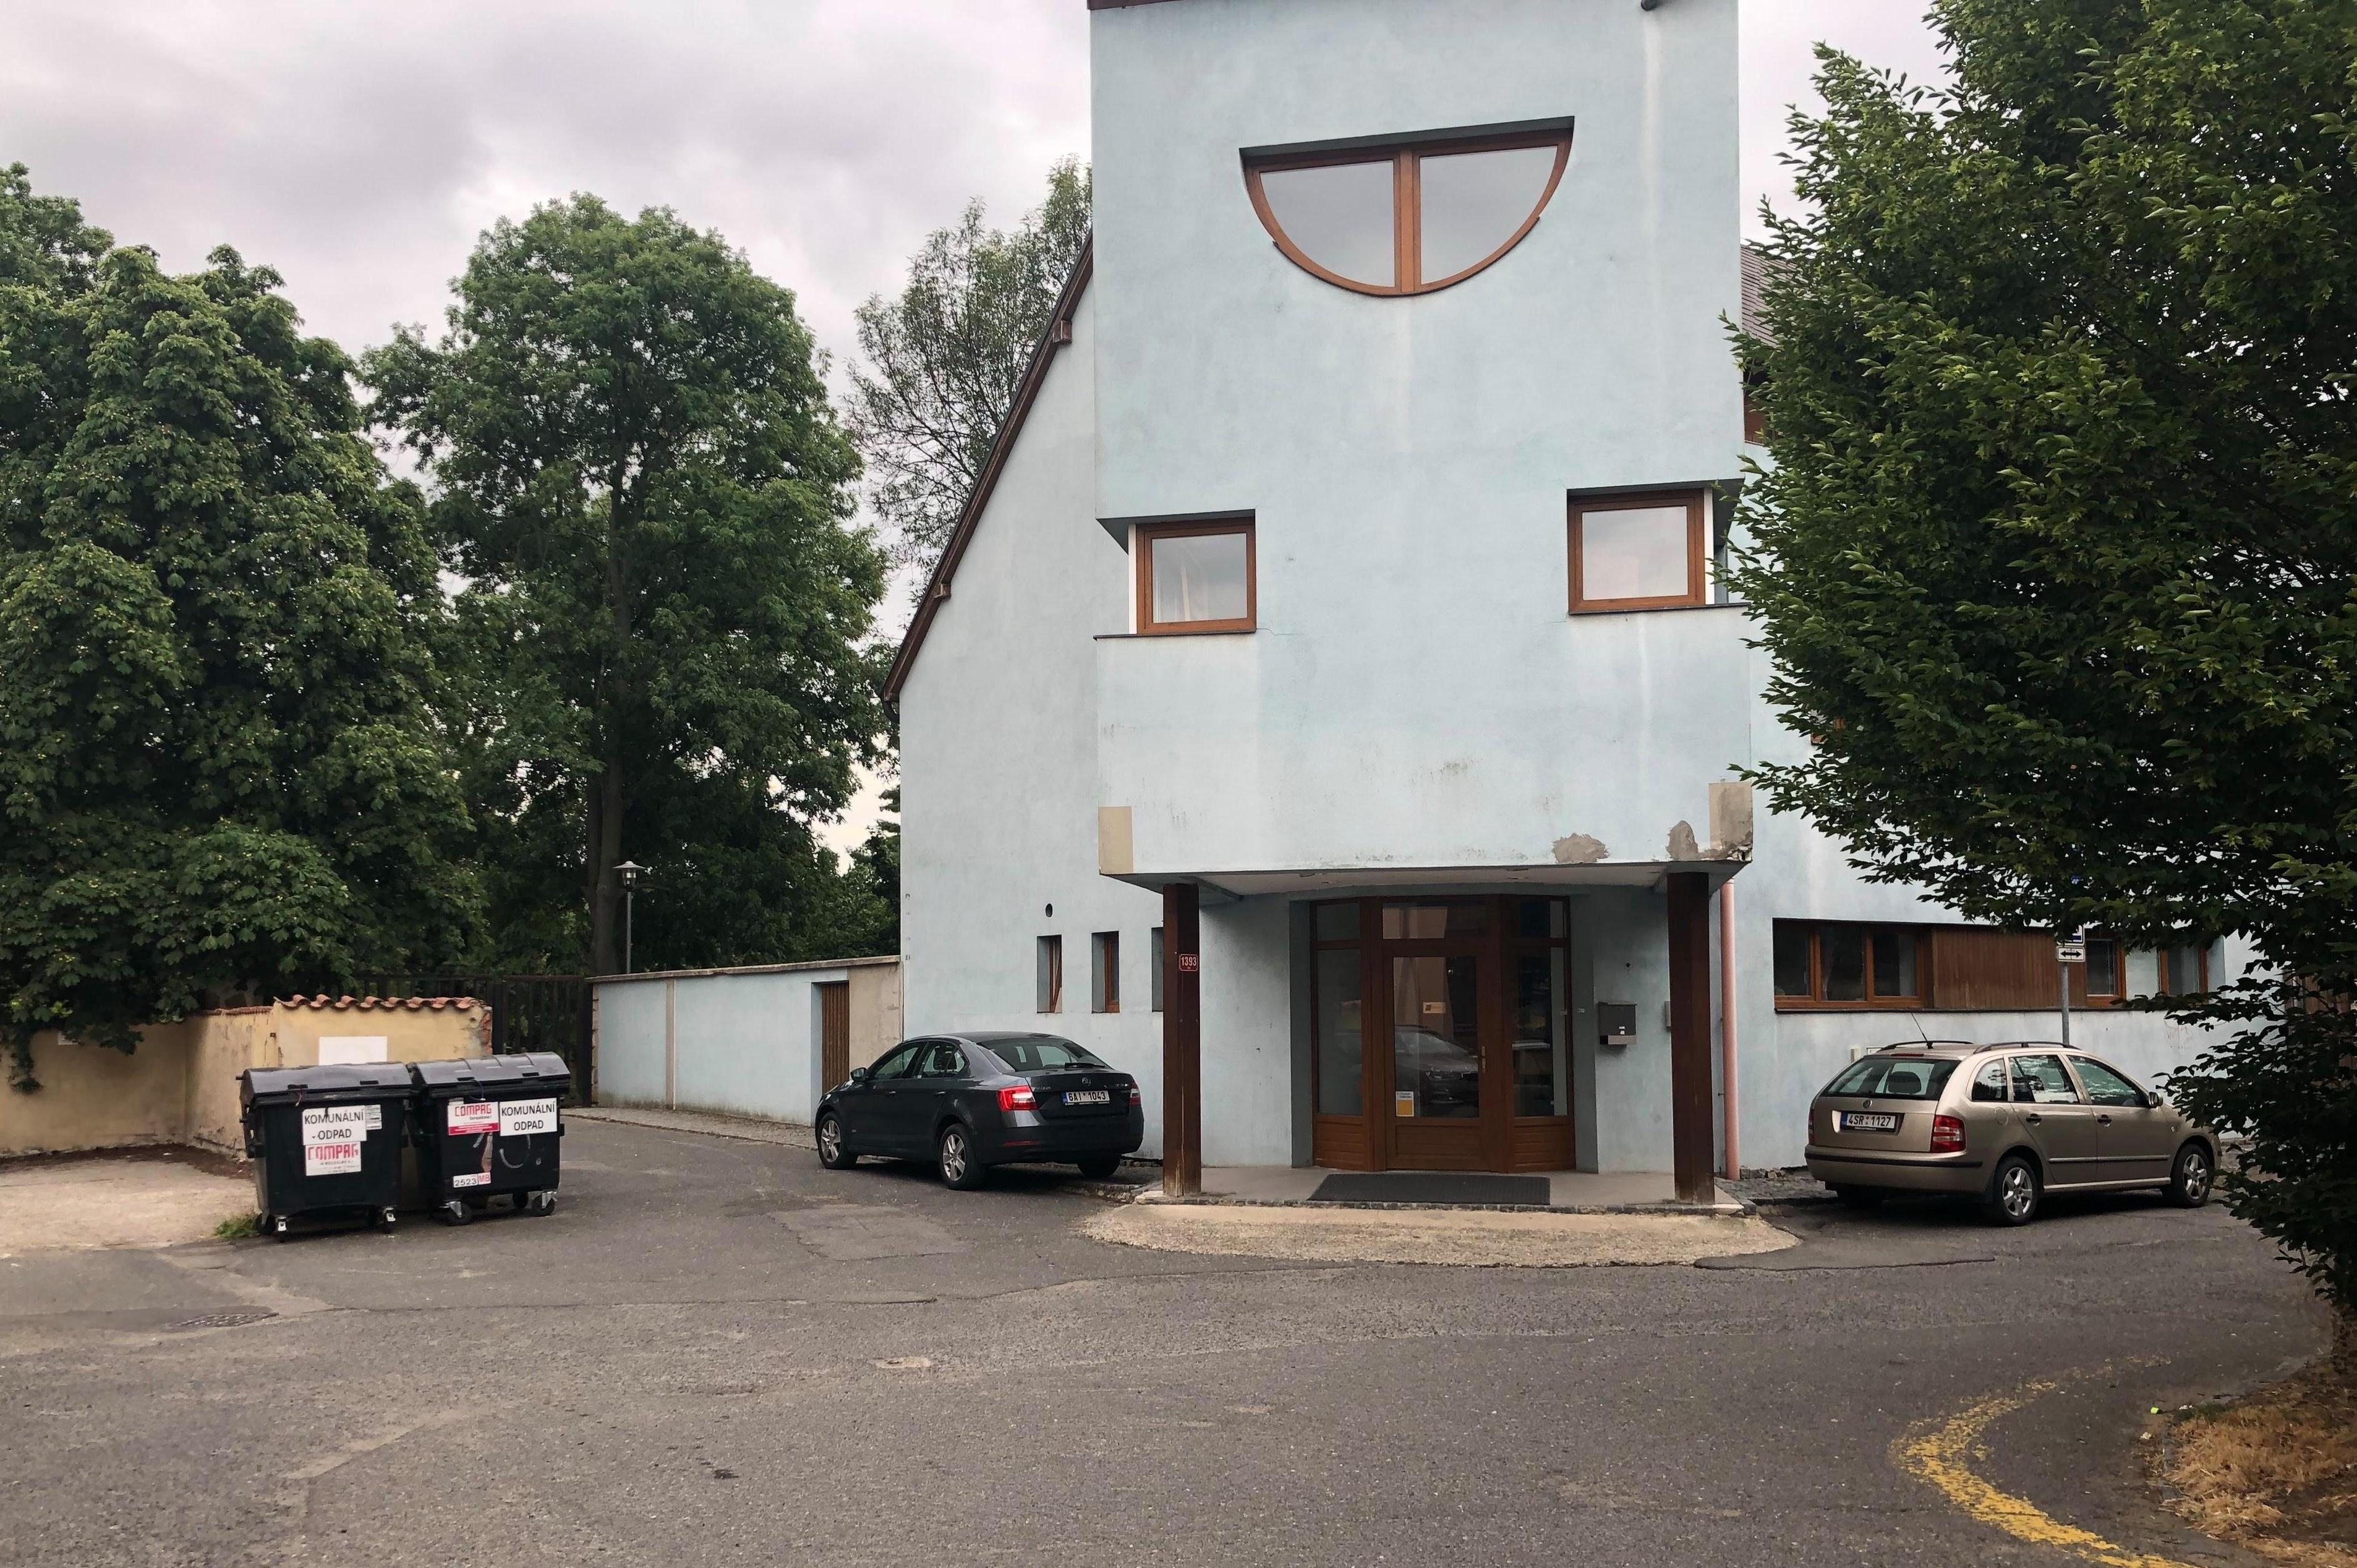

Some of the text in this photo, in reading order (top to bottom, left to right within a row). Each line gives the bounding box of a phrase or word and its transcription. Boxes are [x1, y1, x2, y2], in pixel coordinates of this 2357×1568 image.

[1181, 957, 1197, 966] 1393
[1088, 1092, 1106, 1101] 1043
[454, 1104, 492, 1117] COMPAG
[501, 1101, 556, 1116] KOMUNÁLNÍ
[304, 1109, 364, 1125] KOMUNÁLNÍ
[1849, 1115, 1891, 1127] 4SR 1127
[514, 1120, 544, 1131] ODPAD
[318, 1128, 352, 1140] ODPAD
[454, 1174, 490, 1187] 2523 MB
